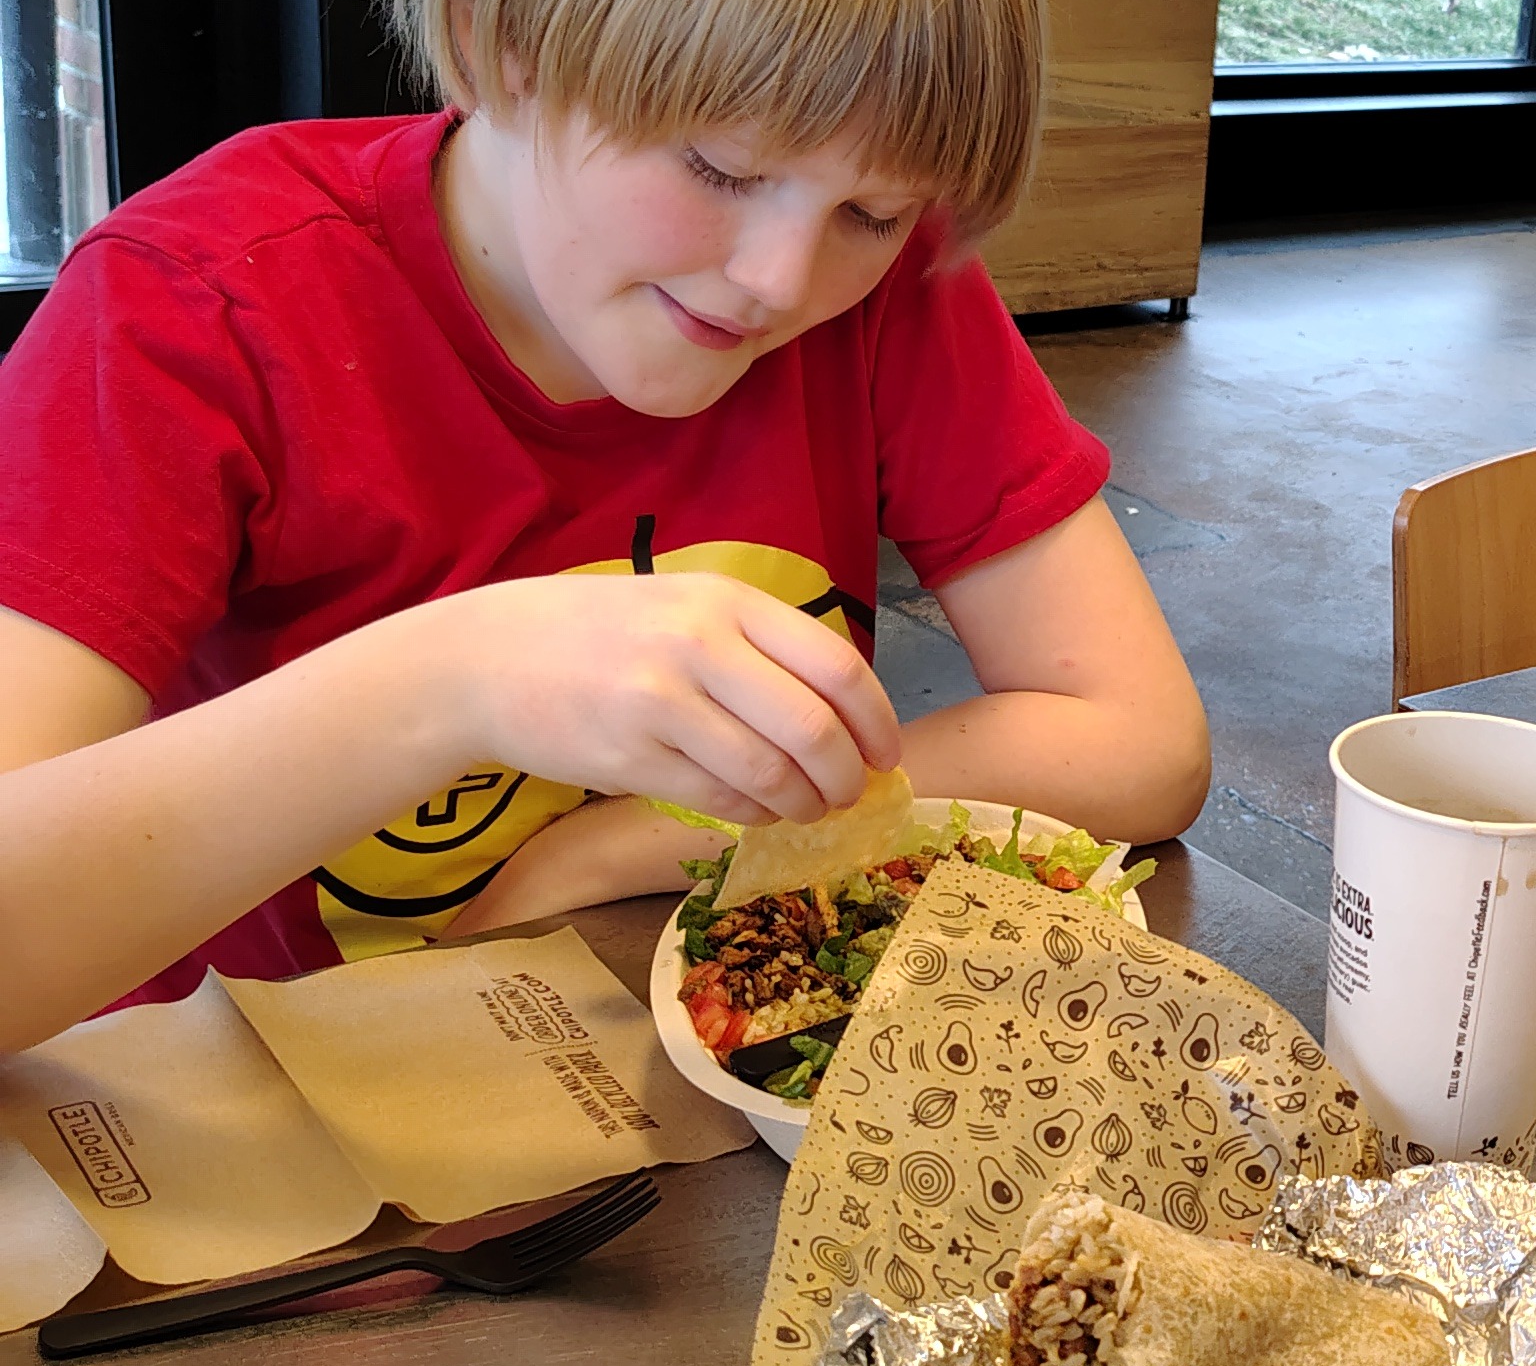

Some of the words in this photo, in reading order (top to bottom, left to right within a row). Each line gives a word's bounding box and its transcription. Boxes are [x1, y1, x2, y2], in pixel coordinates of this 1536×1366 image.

[1466, 970, 1476, 981] AT
[501, 988, 537, 1014] ONLINE
[1463, 984, 1475, 1001] FEEL
[512, 972, 589, 1039] CHIPOTLE.COM
[525, 1014, 558, 1039] ORDER
[1456, 1032, 1467, 1047] YOU
[542, 1055, 570, 1074] WITH
[566, 1049, 610, 1074] PAPER
[1454, 1050, 1464, 1067] HOW
[556, 1071, 586, 1093] MADE
[1451, 1070, 1460, 1079] US
[572, 1089, 592, 1100] IS
[586, 1074, 640, 1109] RECYCLED
[1447, 1081, 1459, 1099] TELL
[578, 1097, 613, 1123] NAPKIN
[598, 1120, 624, 1138] THIS
[62, 1108, 124, 1183] CHIPOTLE
